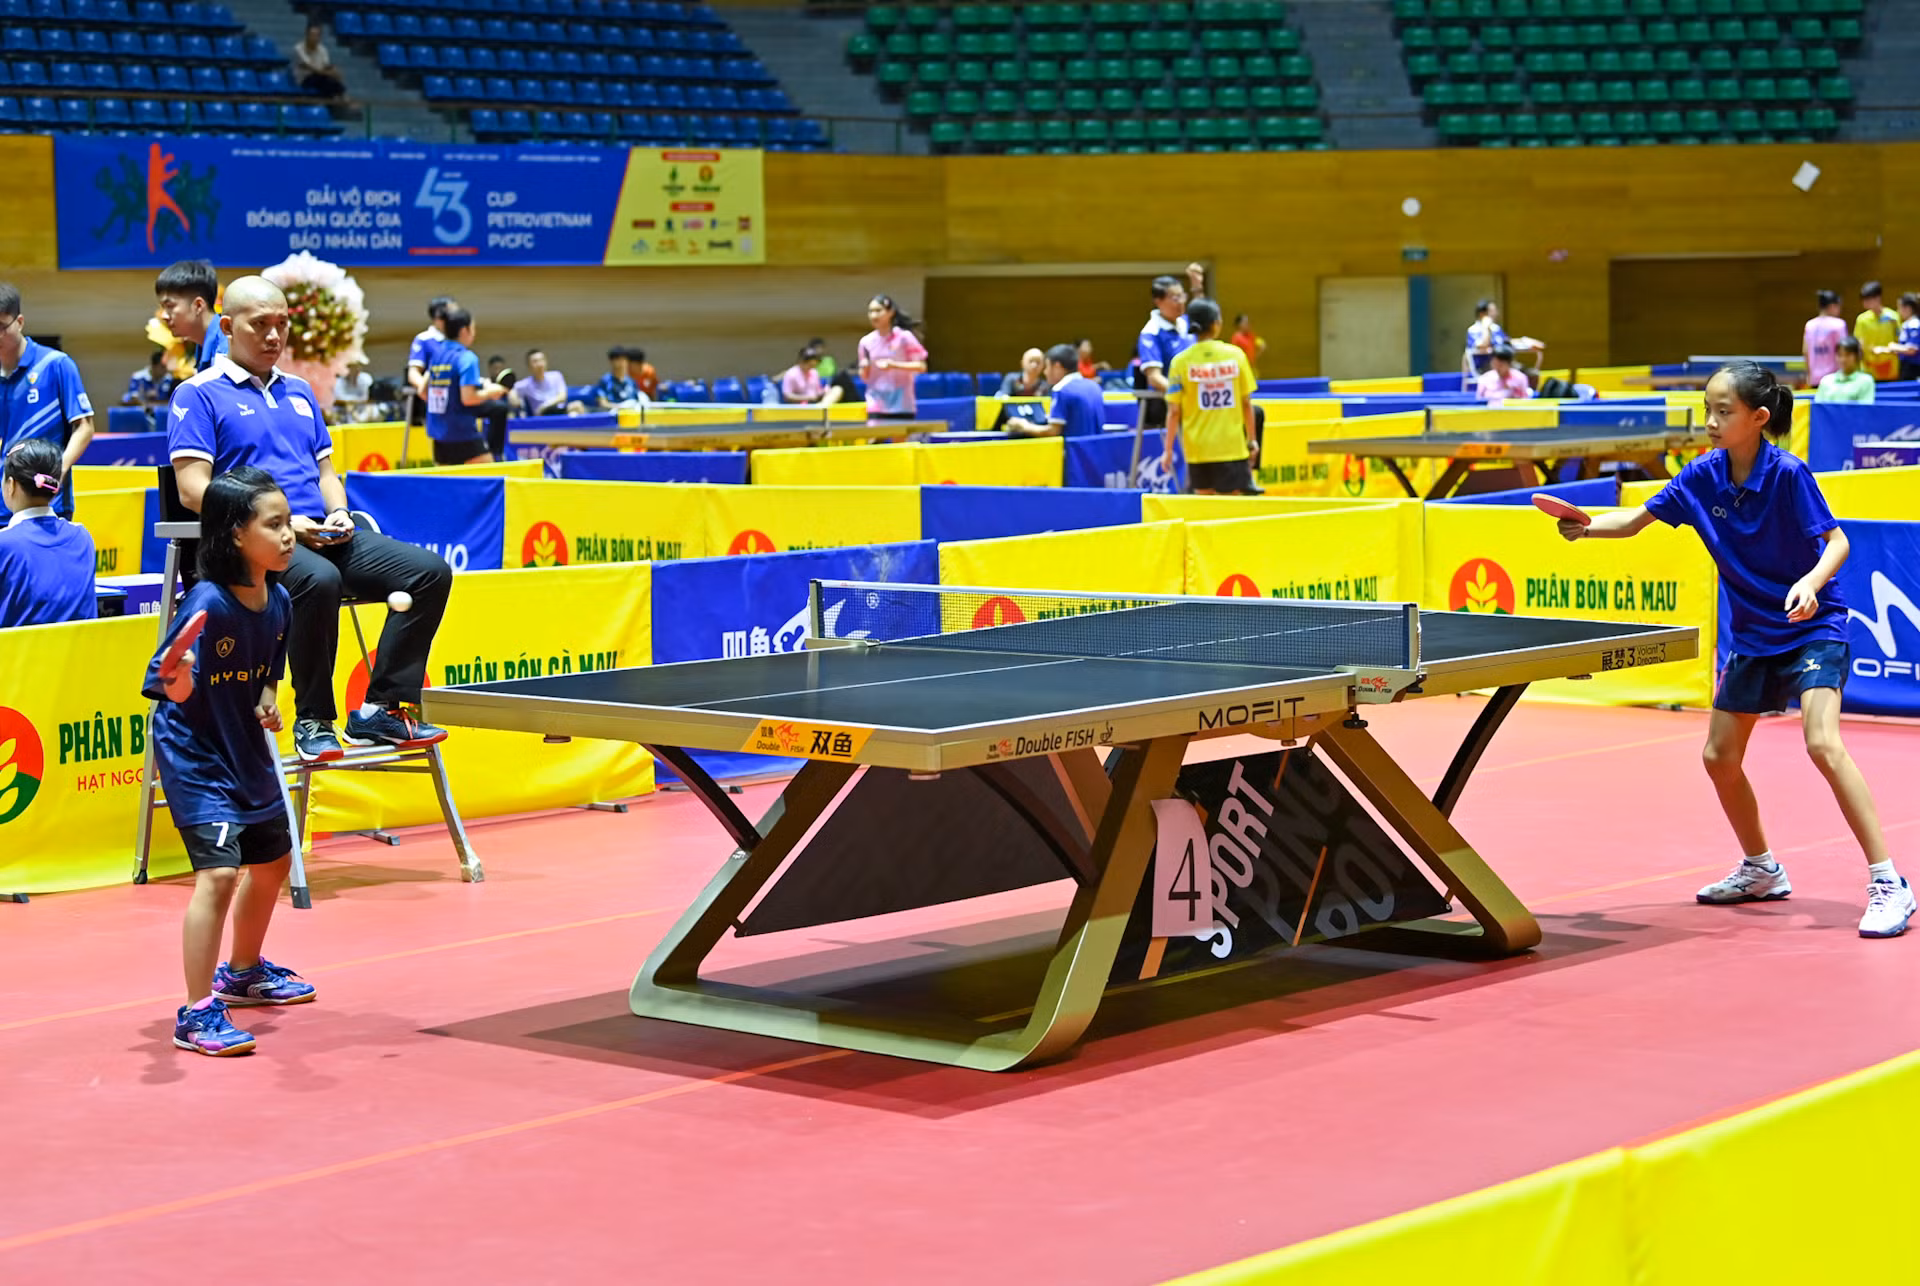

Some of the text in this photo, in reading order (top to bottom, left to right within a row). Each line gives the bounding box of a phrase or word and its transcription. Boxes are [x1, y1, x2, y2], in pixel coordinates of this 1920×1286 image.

[1201, 389, 1233, 408] 022
[575, 533, 608, 562] PHÂN
[611, 533, 634, 562] BÓN
[1526, 571, 1678, 612] PHÂN BÓN CÀ MAU
[1199, 696, 1305, 731] MOFIT
[58, 710, 123, 765] PHÂN
[809, 729, 852, 758] 双鱼
[1015, 731, 1063, 756] Double
[1065, 728, 1095, 749] FISH
[77, 773, 106, 794] HẠT
[211, 821, 230, 848] 7
[1194, 760, 1275, 959] SPORT
[1167, 837, 1202, 923] 4
